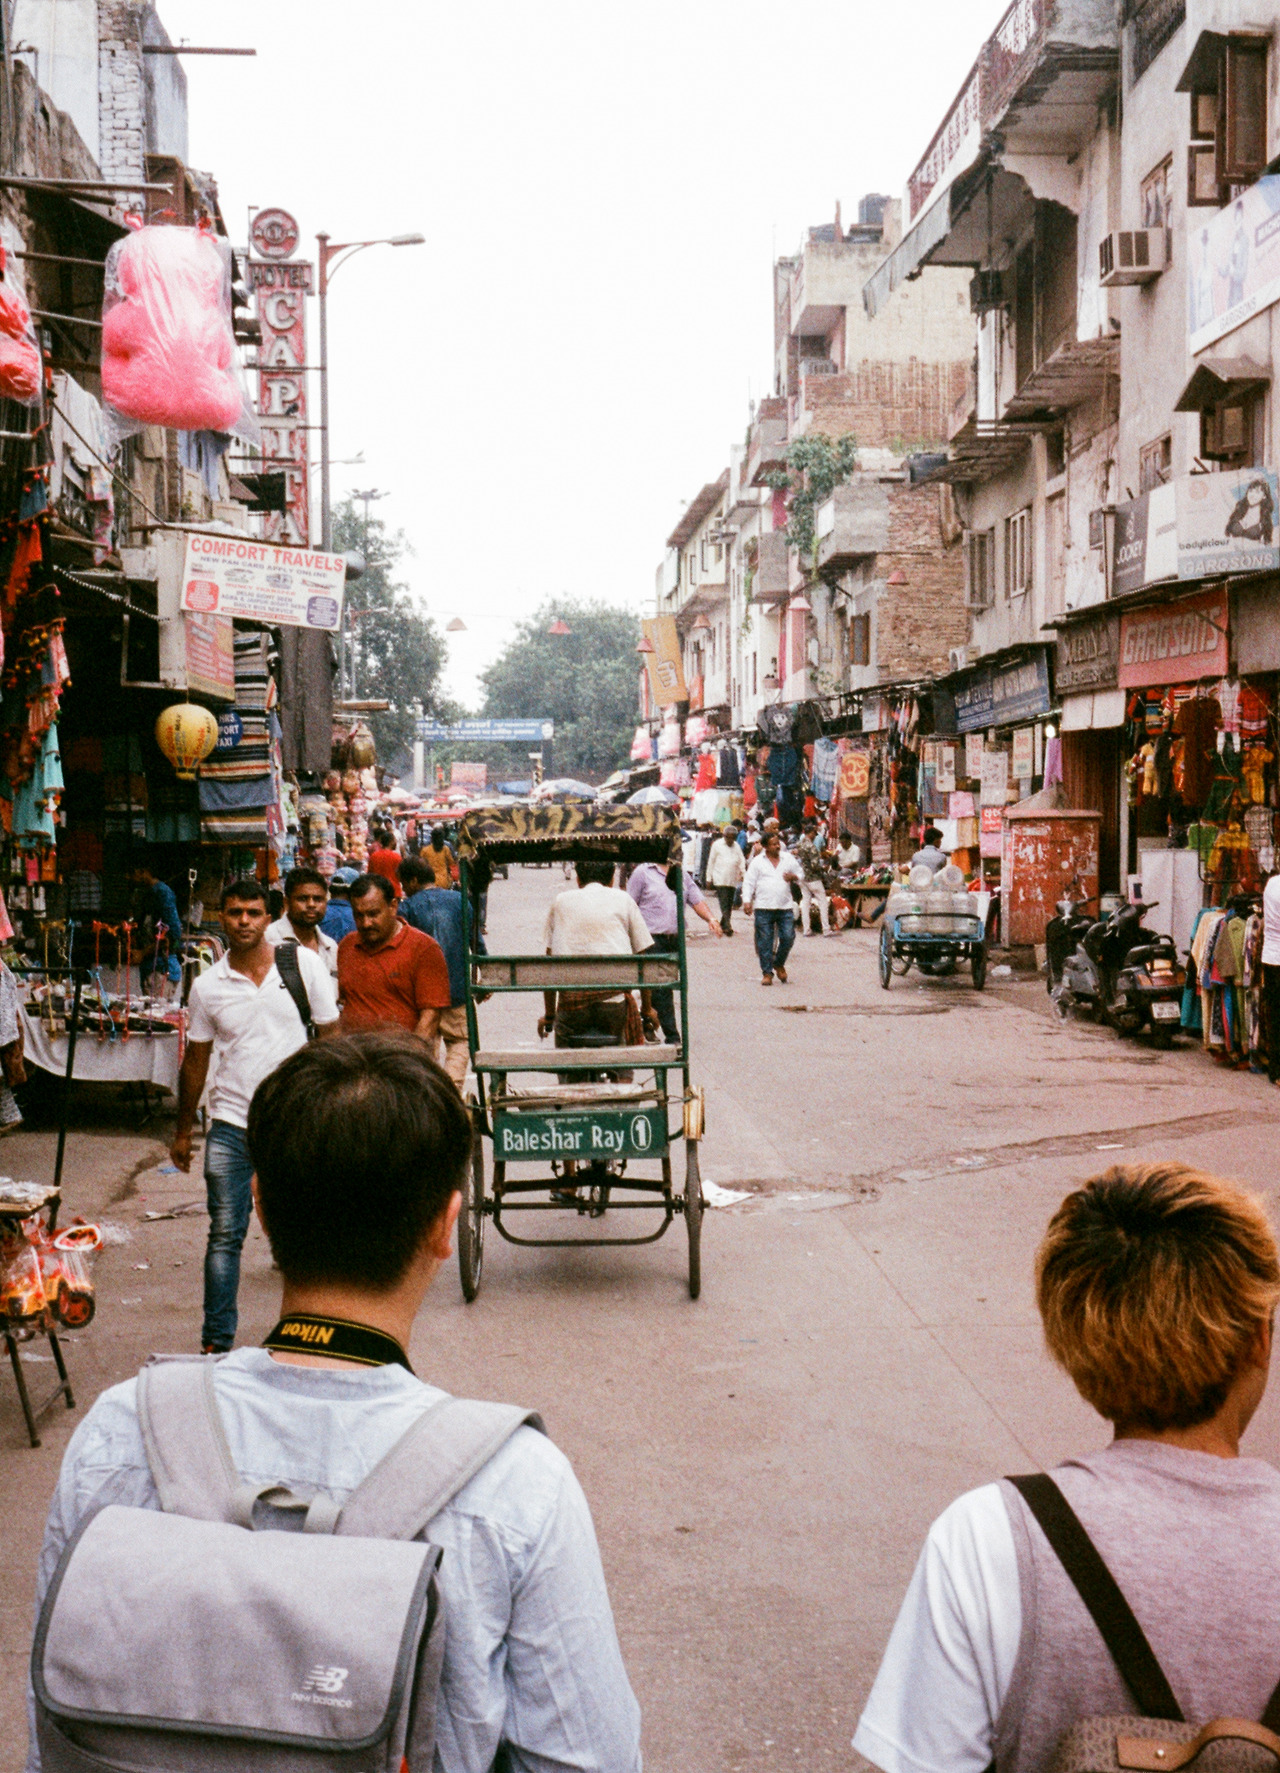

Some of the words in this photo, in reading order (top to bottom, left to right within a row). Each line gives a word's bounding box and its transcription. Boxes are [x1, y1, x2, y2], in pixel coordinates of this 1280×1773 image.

[251, 265, 309, 288] HOTEL
[191, 538, 268, 561] COMFORT
[273, 549, 344, 573] TRAVELS
[200, 556, 220, 564] NEW
[1184, 553, 1274, 575] GARGSONS
[502, 1125, 583, 1151] Baleshar
[591, 1125, 625, 1152] Ray
[633, 1117, 649, 1148] 1
[281, 1322, 335, 1345] Nikon
[290, 1692, 312, 1702] new
[312, 1694, 353, 1708] balance
